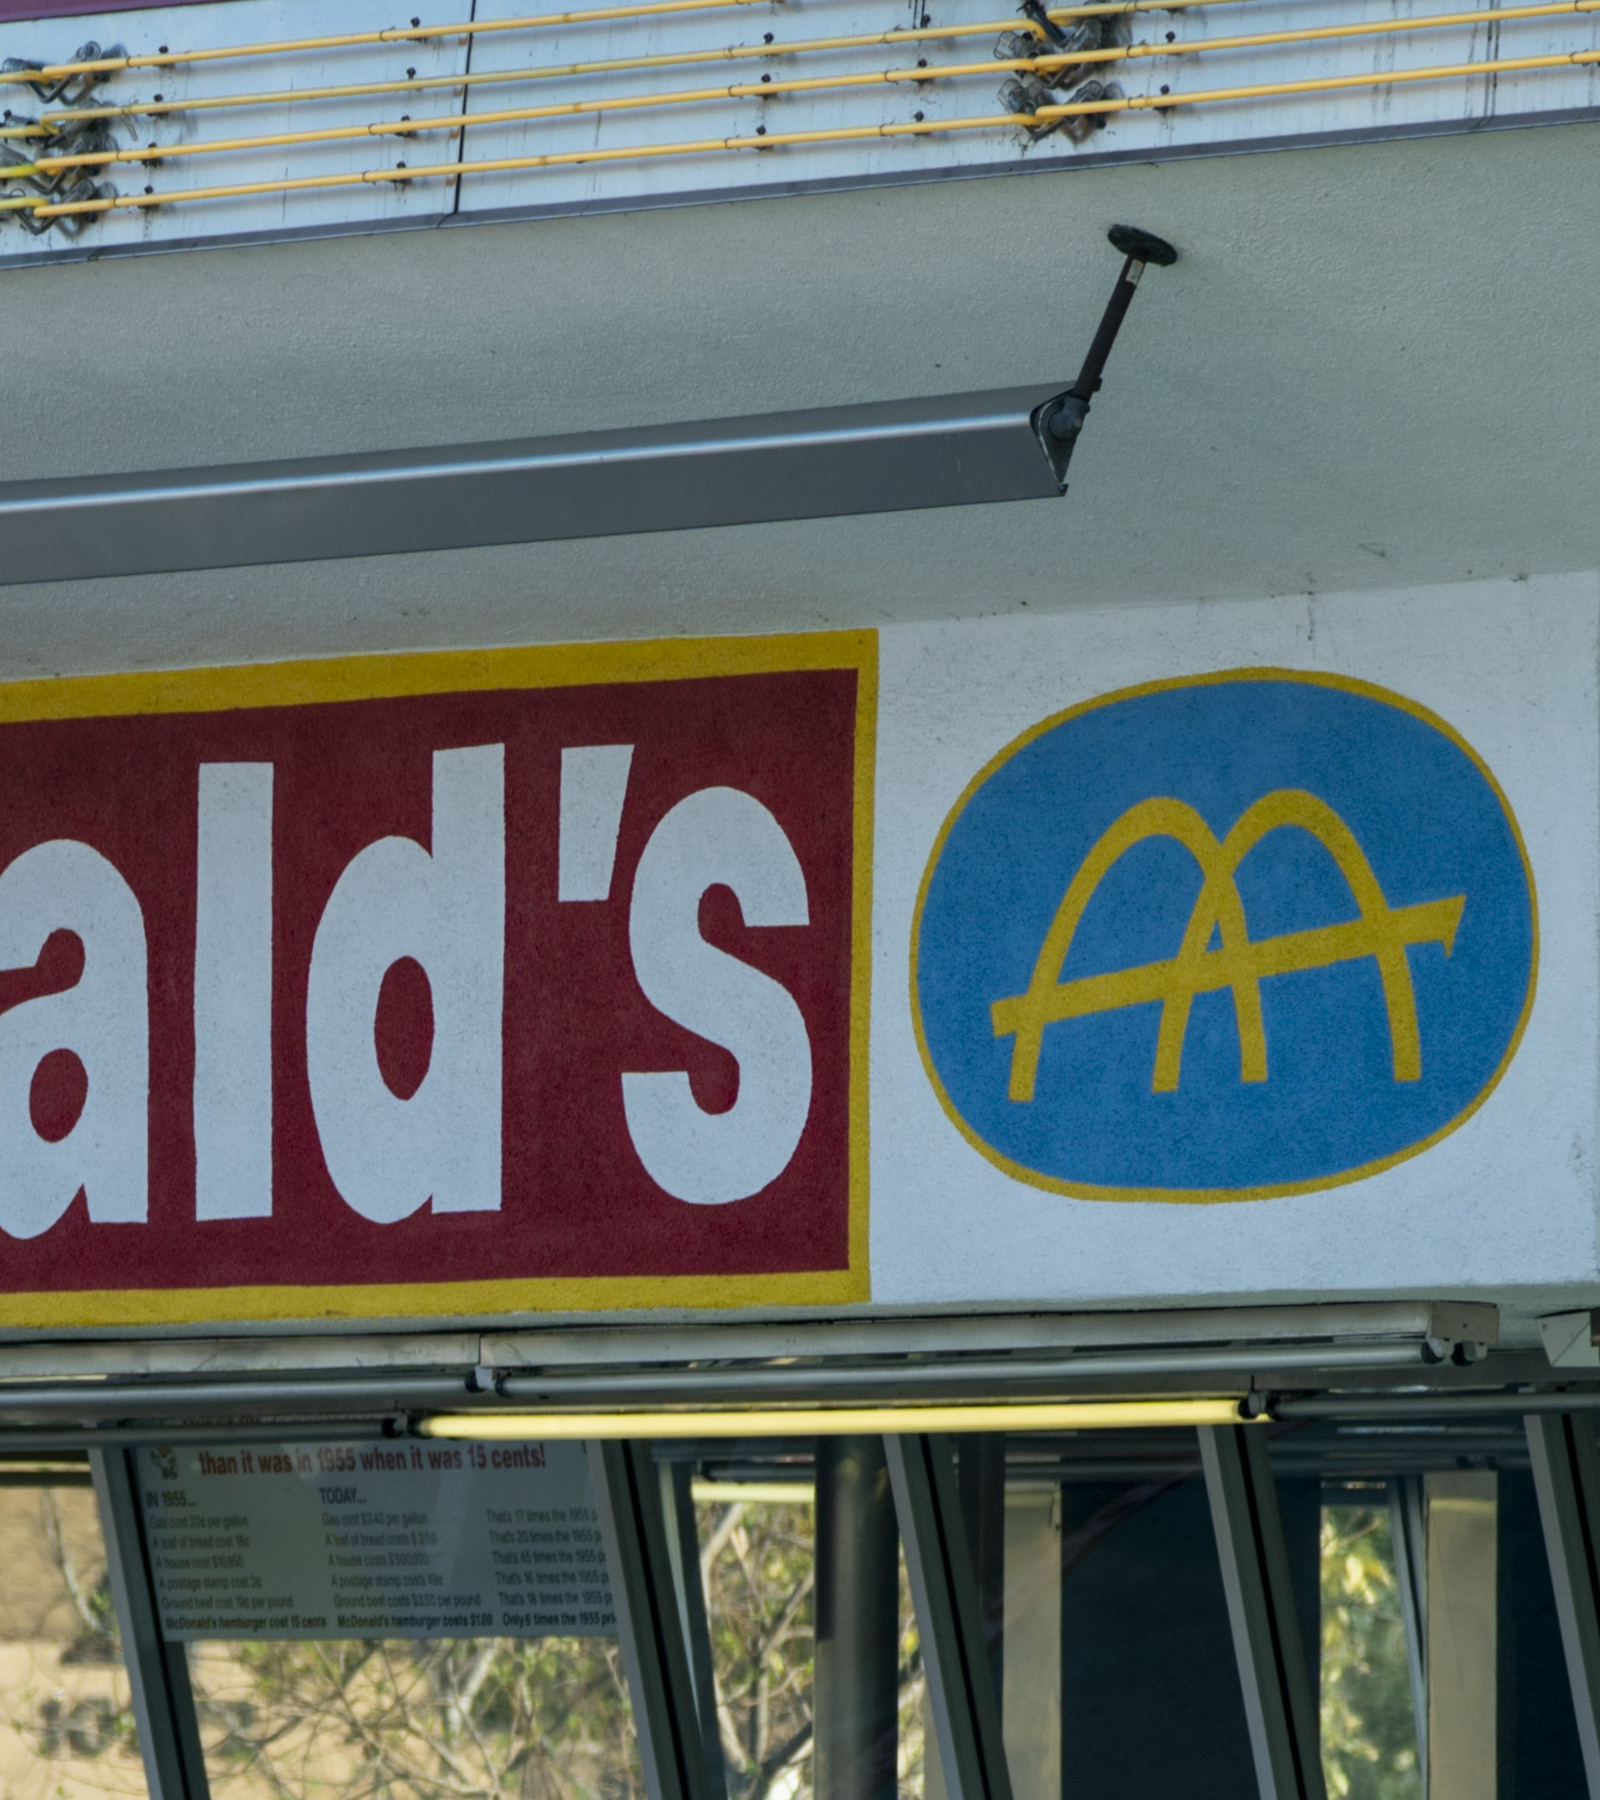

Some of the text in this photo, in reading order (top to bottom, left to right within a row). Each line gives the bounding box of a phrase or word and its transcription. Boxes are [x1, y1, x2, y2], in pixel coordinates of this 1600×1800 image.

[199, 1443, 547, 1475] than it was in 1955 when it was 15 cents!
[146, 1490, 159, 1508] IN
[568, 1507, 590, 1521] 1955
[571, 1529, 593, 1542] 1955
[166, 1615, 327, 1632] McDonald's hamburger cost 15 cents
[337, 1611, 493, 1631] McDonald's hamburger costs $1.00
[502, 1612, 524, 1629] Only
[533, 1611, 559, 1625] times
[560, 1611, 577, 1625] the
[578, 1610, 601, 1625] 1955
